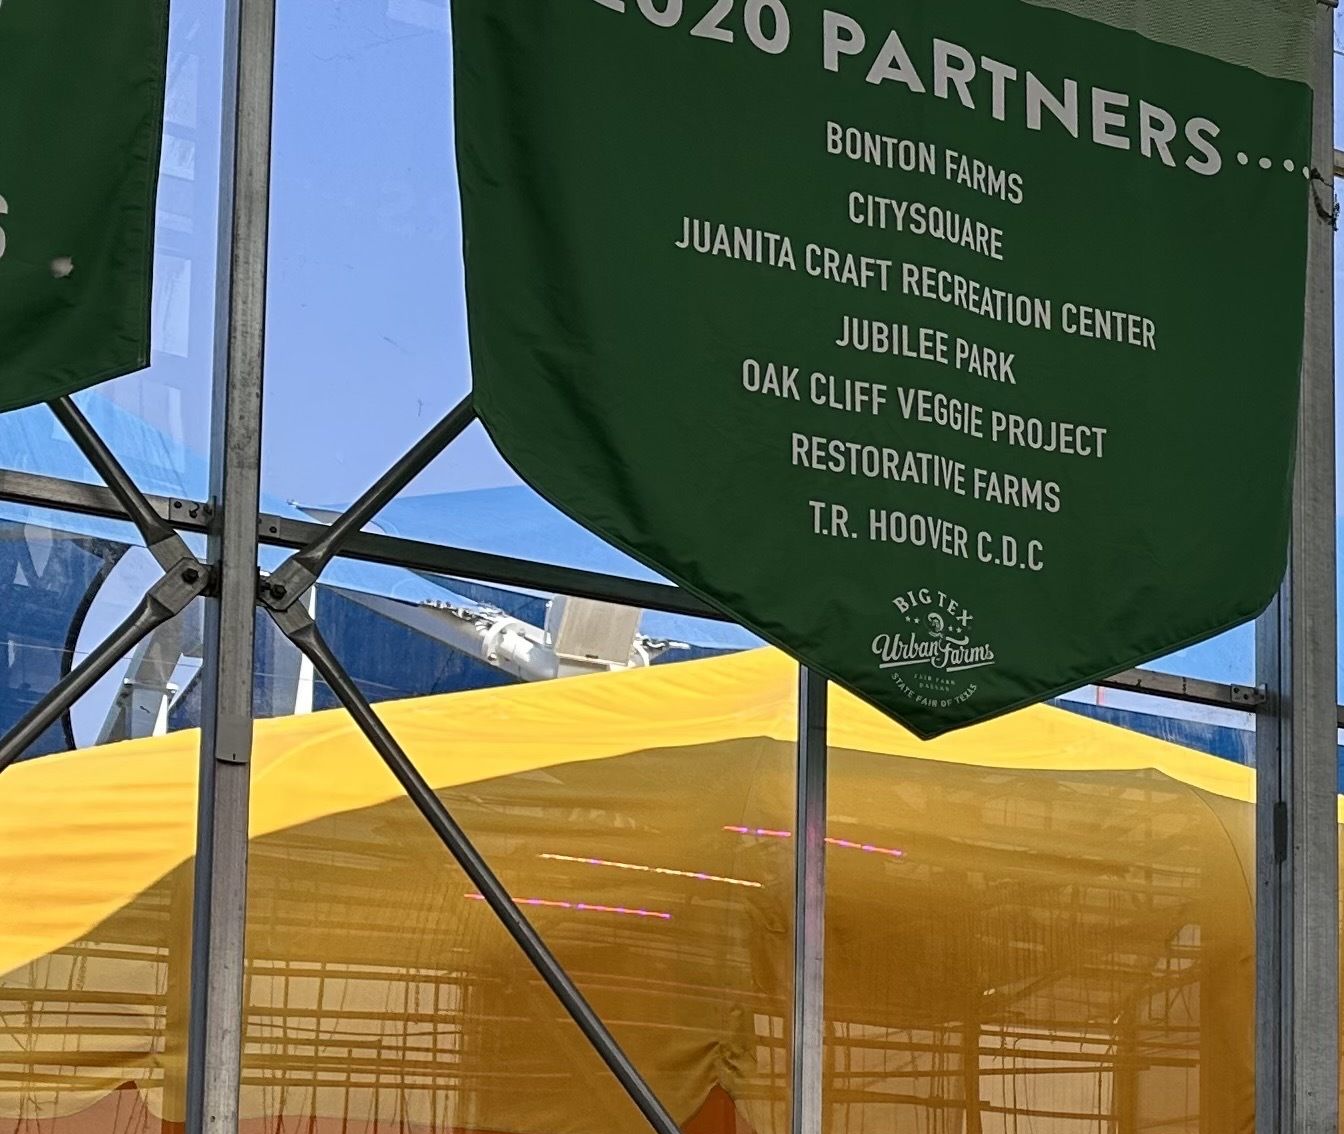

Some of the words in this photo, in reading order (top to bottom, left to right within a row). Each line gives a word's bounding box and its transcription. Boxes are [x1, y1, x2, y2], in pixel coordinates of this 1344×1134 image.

[592, 0, 790, 54] 20
[823, 9, 1222, 176] PARTNERS
[826, 121, 936, 175] BONTON
[945, 149, 1023, 204] FARMS
[849, 191, 1004, 260] CITYSQUARE
[675, 216, 796, 271] JUANITA
[805, 243, 892, 291] CRAFT
[902, 262, 1051, 330] RECREATION
[1061, 302, 1156, 351] CENTER
[835, 315, 948, 365] JUBILEE
[955, 342, 1016, 384] PARK
[742, 358, 800, 402] OAK
[810, 372, 887, 416] CLIFF
[897, 387, 983, 438] VEGGIE
[991, 411, 1107, 459] PROJECT
[791, 432, 966, 496] RESTORATIVE
[973, 468, 1061, 513] FARMS
[809, 501, 857, 540] T.R.
[869, 509, 968, 559] HOOVER
[977, 532, 1044, 572] C.D.C
[892, 588, 932, 613] BIG
[937, 591, 974, 626] TEX
[871, 632, 939, 661] Urban
[931, 636, 994, 668] Farms
[891, 672, 915, 698] STATE
[915, 695, 938, 707] FAIR
[940, 698, 952, 707] OF
[954, 683, 977, 704] TEXAS
